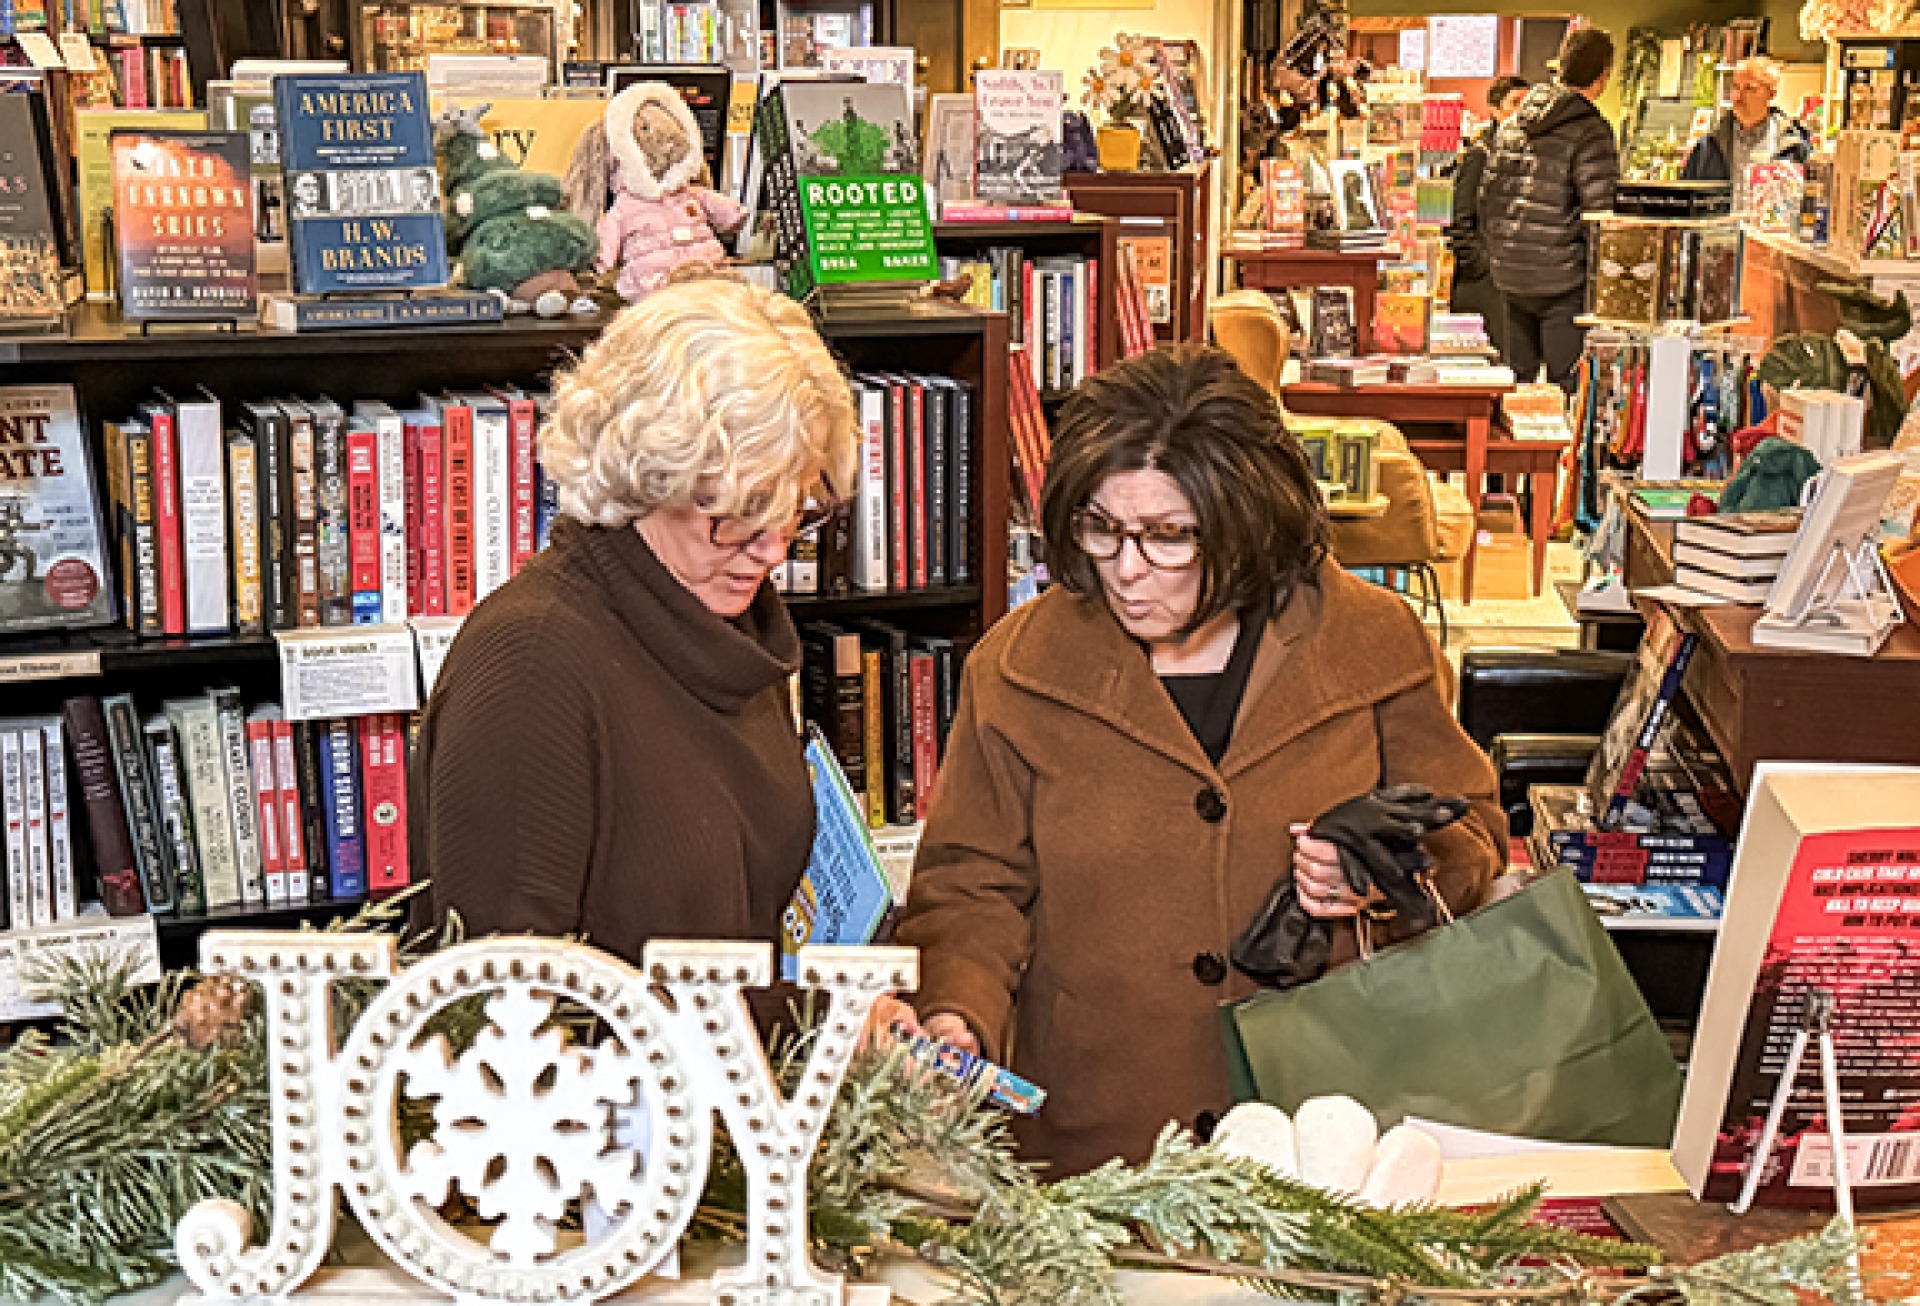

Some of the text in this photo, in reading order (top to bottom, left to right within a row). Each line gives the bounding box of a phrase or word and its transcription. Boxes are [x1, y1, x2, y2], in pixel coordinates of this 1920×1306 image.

[298, 92, 415, 117] AMERICA
[322, 119, 395, 142] FIRST
[155, 156, 214, 178] INTO
[128, 185, 245, 208] UNKNOWN
[807, 182, 918, 207] ROOTED
[152, 215, 225, 238] SKIES
[321, 245, 426, 271] BRANDS
[176, 930, 920, 1306] JOY
